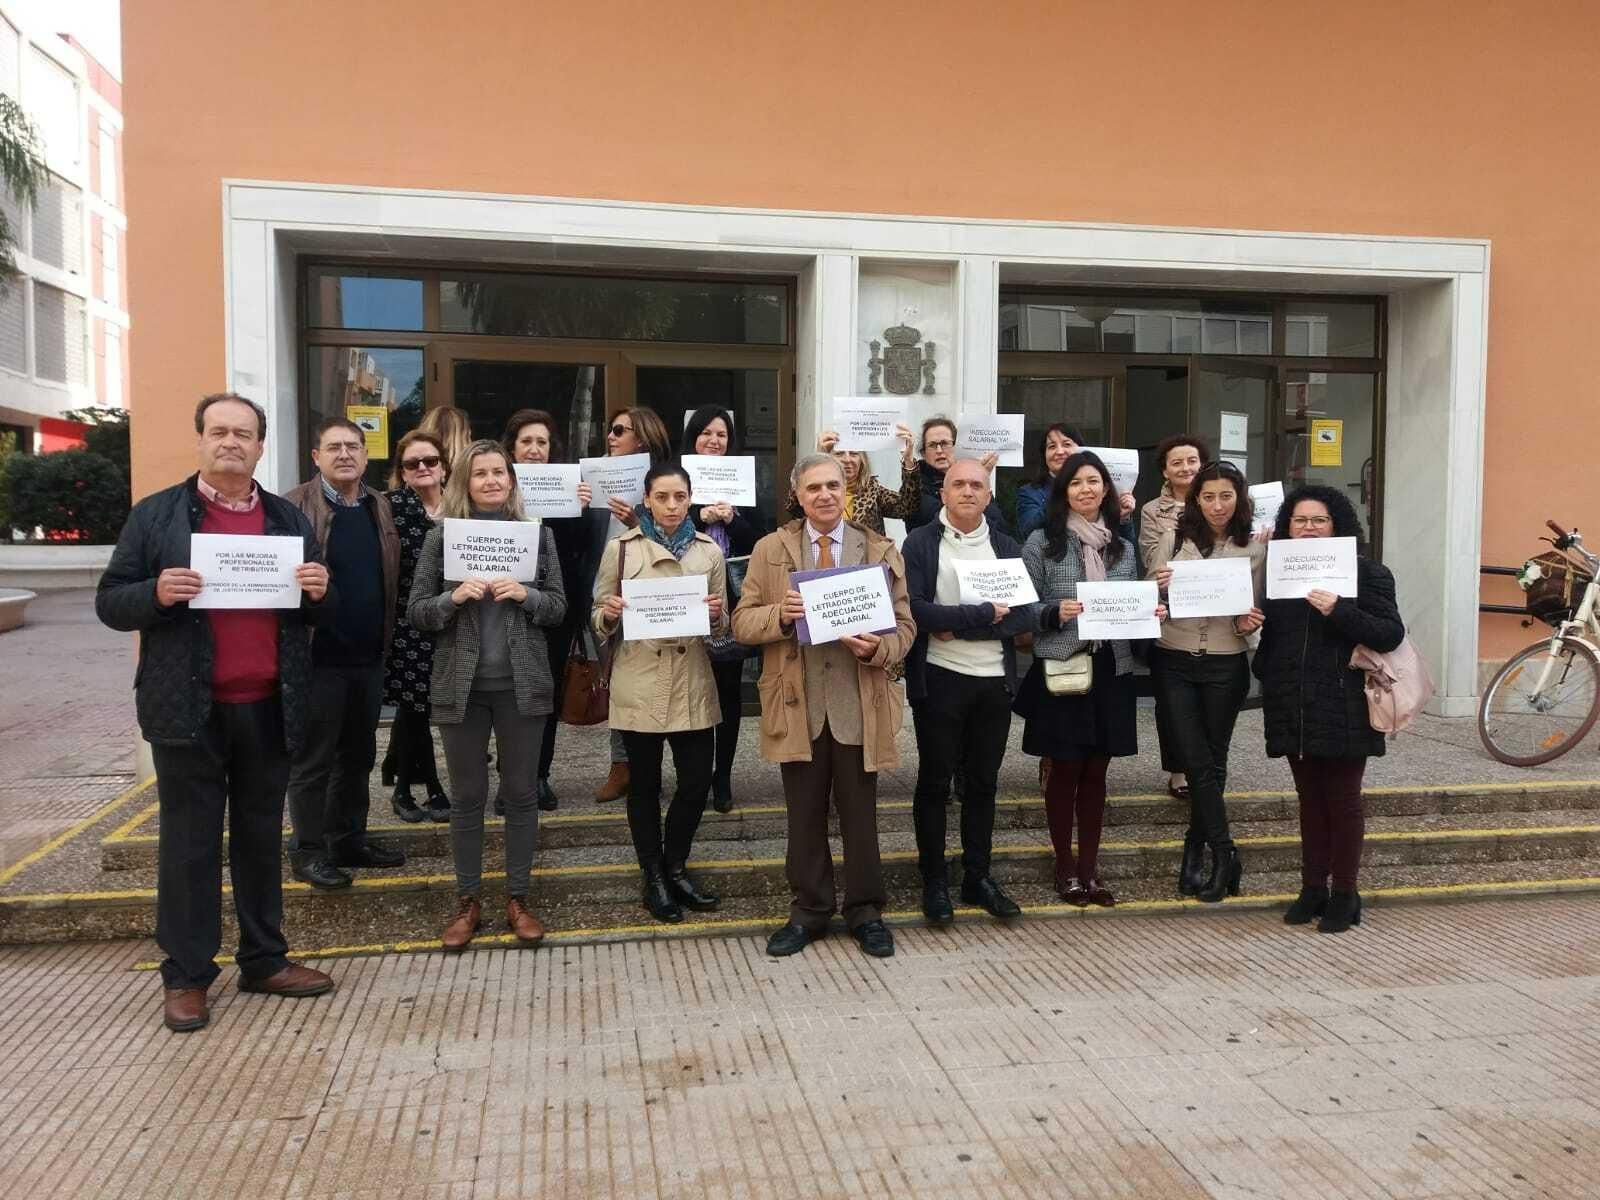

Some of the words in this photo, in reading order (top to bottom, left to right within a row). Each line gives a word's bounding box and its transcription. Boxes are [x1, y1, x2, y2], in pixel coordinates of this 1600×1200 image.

[466, 535, 501, 544] CUERPO
[451, 543, 496, 552] LETRADOS
[466, 563, 512, 572] SALARIAL
[823, 588, 854, 600] CUERPO
[812, 598, 852, 612] LETRADOS
[853, 594, 869, 603] POR
[871, 591, 882, 599] LA
[830, 613, 872, 627] SALARIAL
